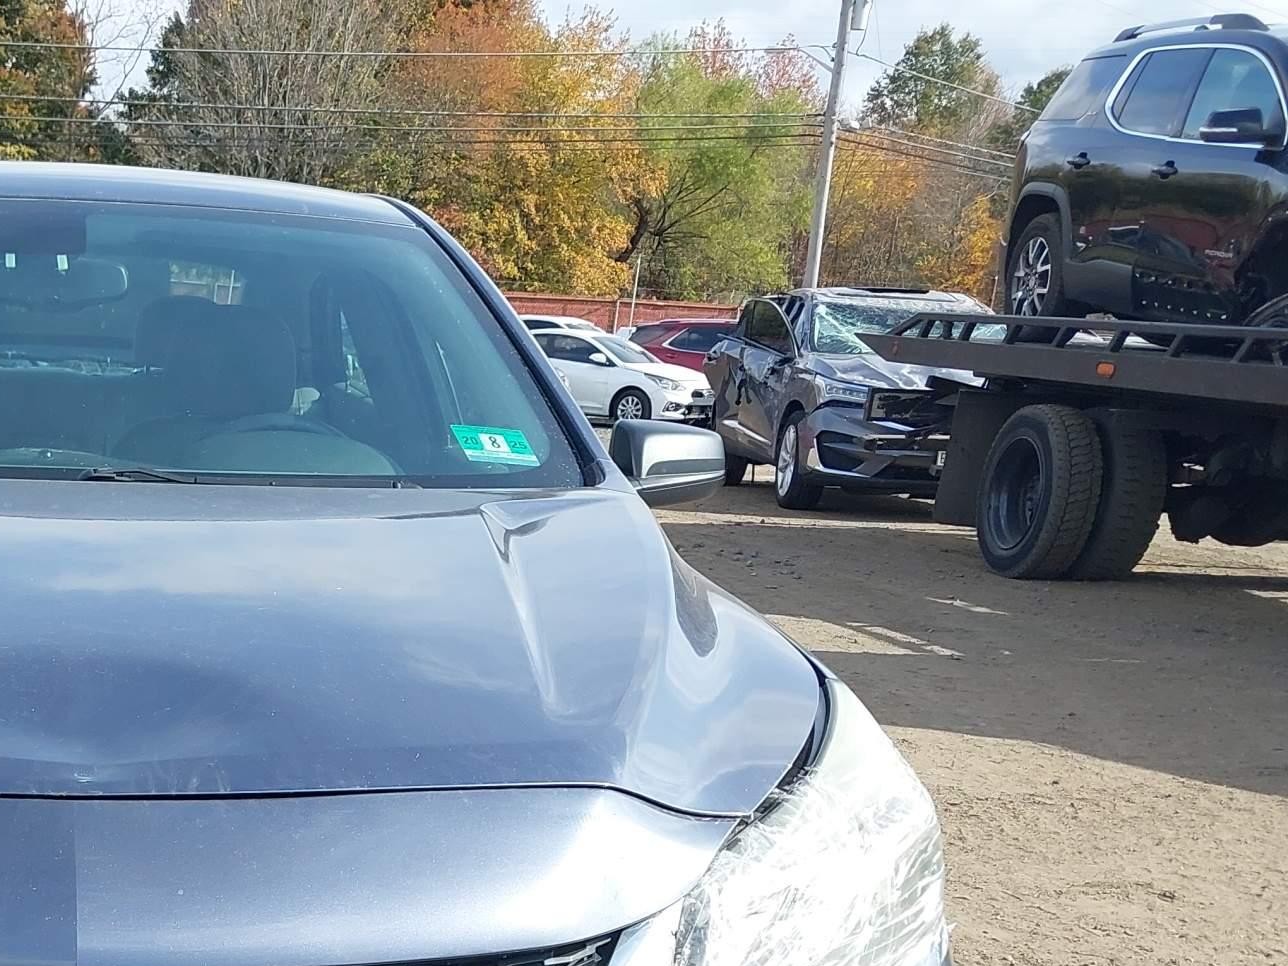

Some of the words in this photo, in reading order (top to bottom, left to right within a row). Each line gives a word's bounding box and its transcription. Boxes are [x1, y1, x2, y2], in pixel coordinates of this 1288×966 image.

[461, 435, 479, 446] 20
[488, 436, 501, 449] 8
[509, 440, 528, 450] 25
